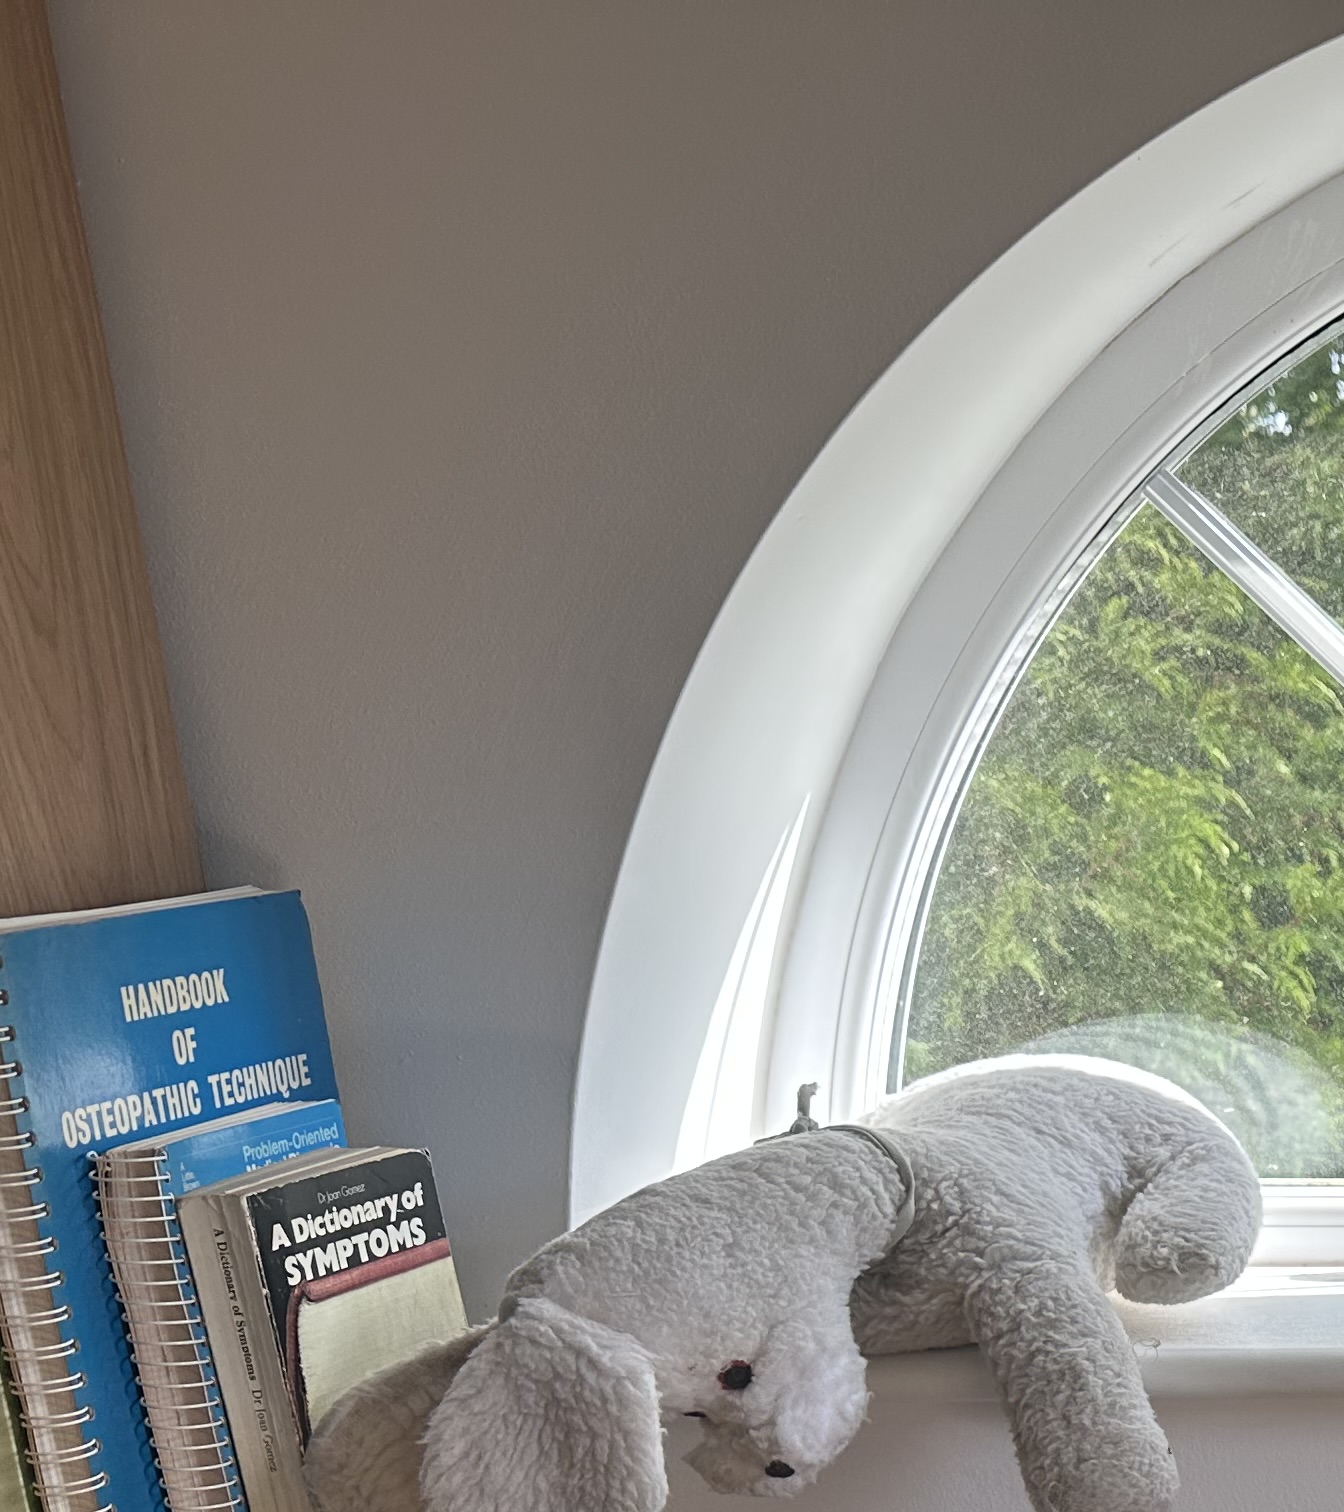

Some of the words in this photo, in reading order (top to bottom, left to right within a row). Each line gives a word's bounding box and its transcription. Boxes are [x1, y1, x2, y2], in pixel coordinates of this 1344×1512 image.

[120, 968, 230, 1022] HANDBOOK
[171, 1027, 197, 1066] OF
[61, 1080, 202, 1148] OSTEOPATHIC
[207, 1053, 312, 1109] TECHNIQUE
[242, 1122, 339, 1163] Problem-Oriented
[271, 1223, 291, 1251] A
[291, 1193, 404, 1244] Dictionary
[401, 1182, 424, 1210] of
[216, 1240, 238, 1301] Dictionary
[284, 1217, 427, 1286] SYMPTOMS
[232, 1305, 244, 1319] of
[234, 1319, 257, 1381] Symptoms
